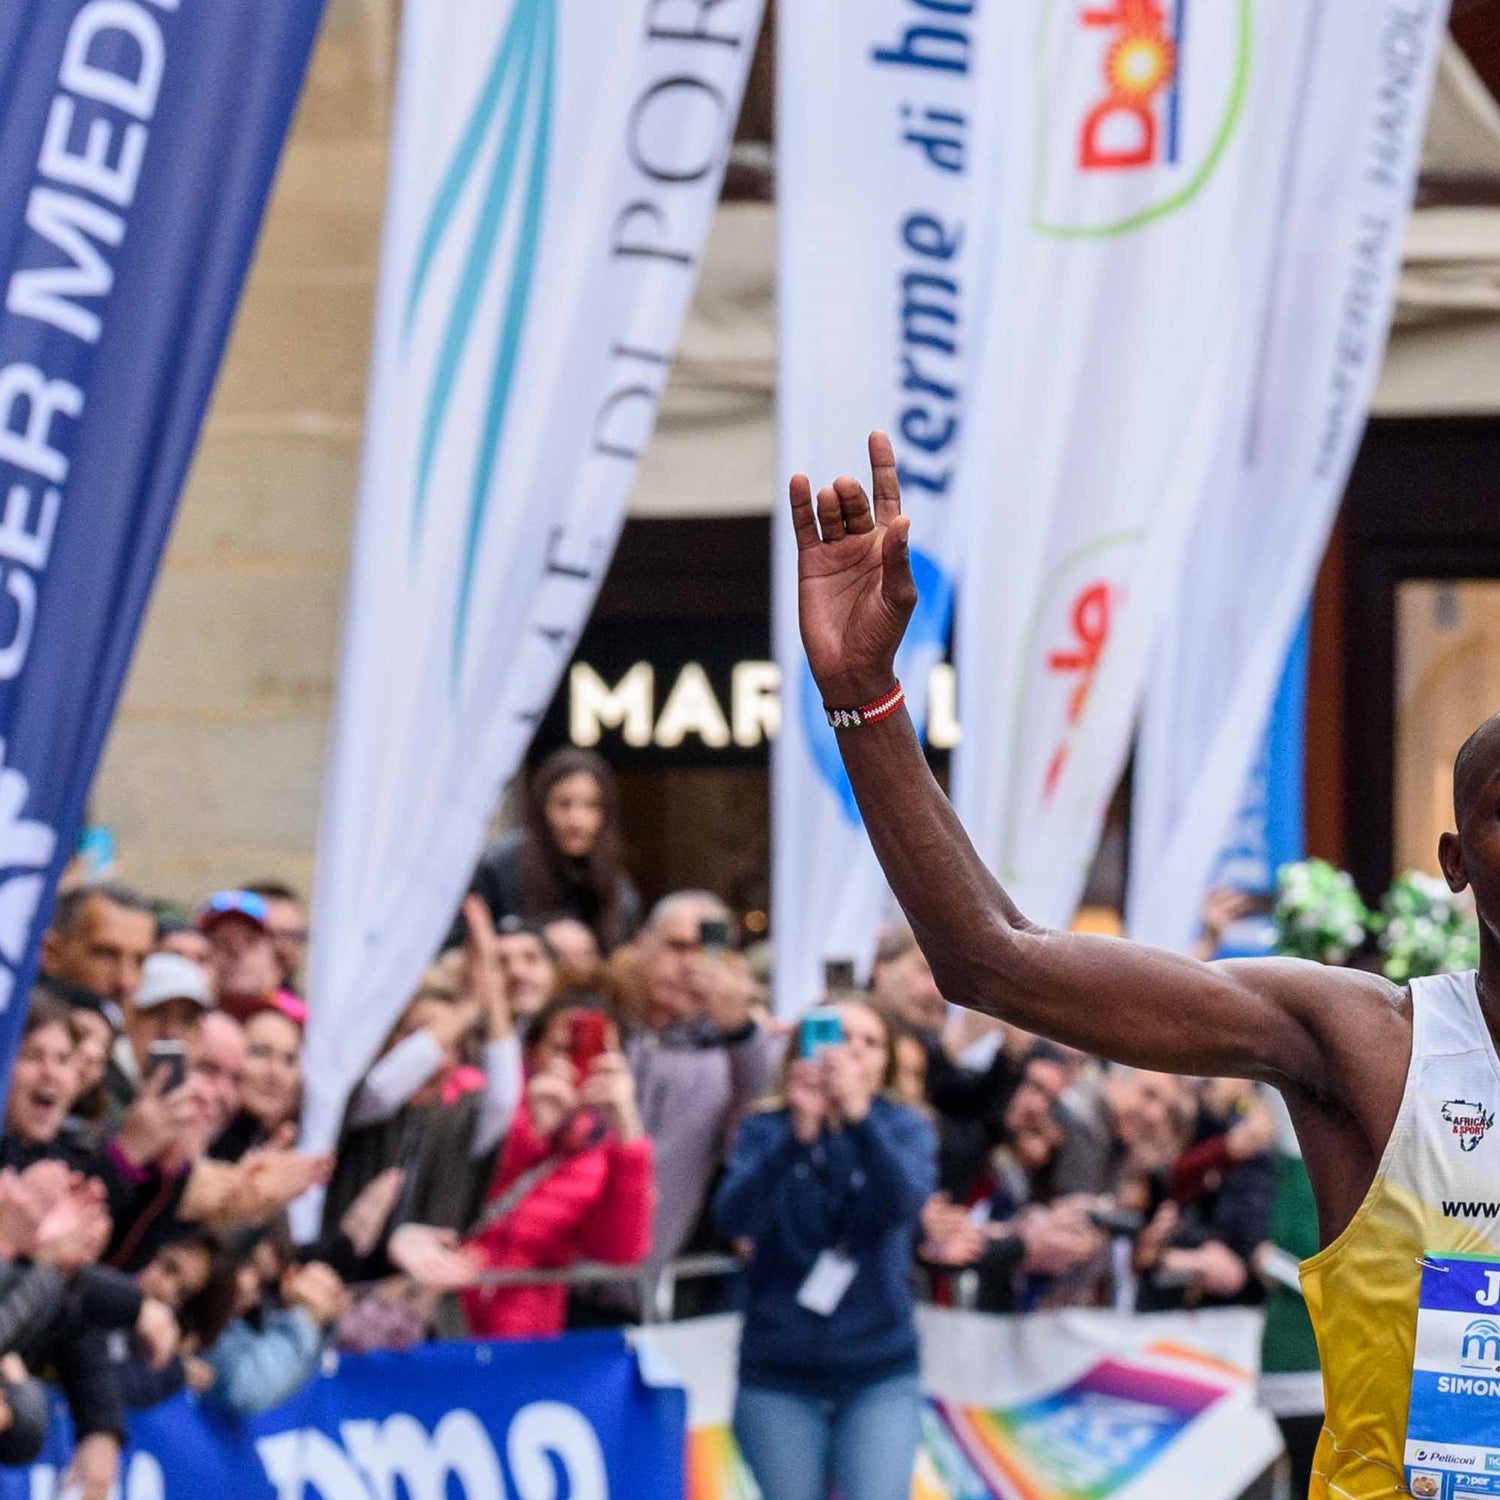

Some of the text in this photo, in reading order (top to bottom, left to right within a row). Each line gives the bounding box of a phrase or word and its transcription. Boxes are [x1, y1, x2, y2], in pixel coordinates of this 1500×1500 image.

[900, 103, 966, 175] di
[8, 0, 180, 344] MED
[1453, 1116, 1486, 1127] AFRICA
[1460, 1126, 1484, 1135] SPORT
[1430, 1452, 1476, 1466] Pelliconi
